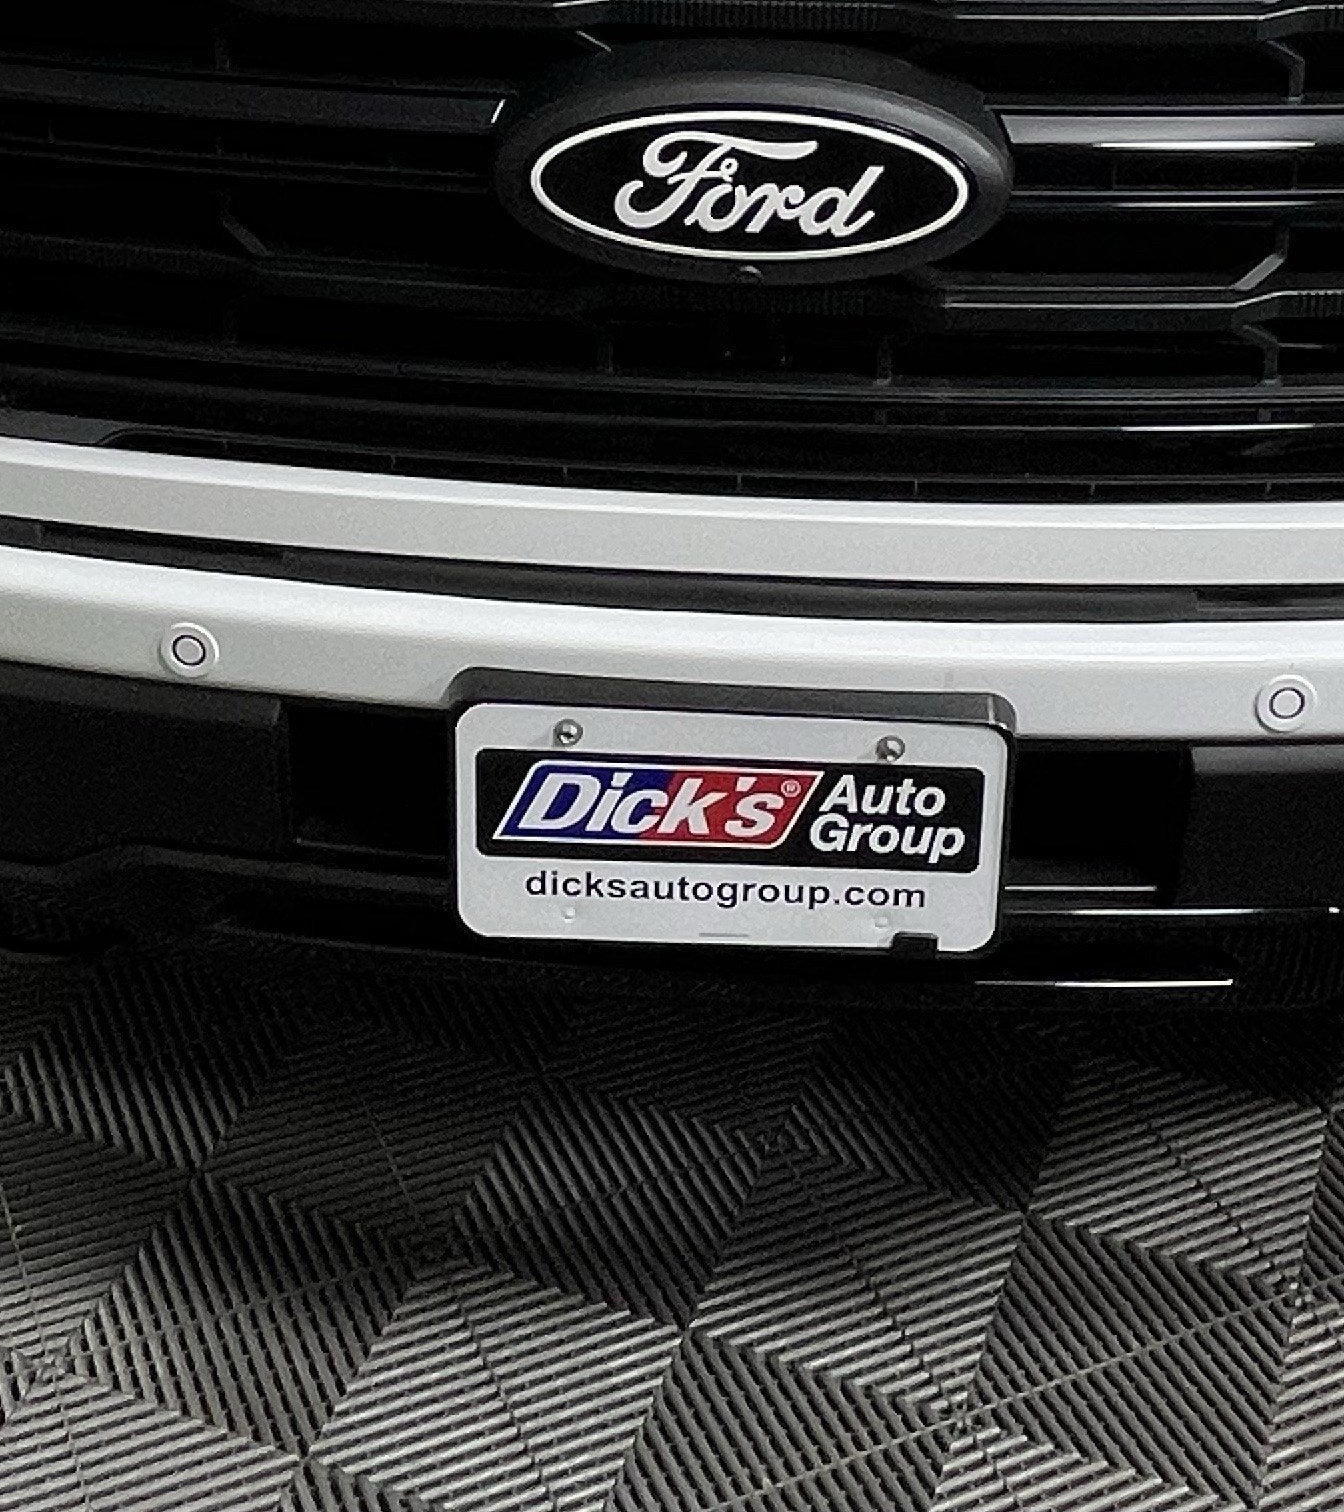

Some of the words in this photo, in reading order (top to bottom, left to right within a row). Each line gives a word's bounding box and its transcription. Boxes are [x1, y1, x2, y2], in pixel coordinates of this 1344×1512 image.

[614, 130, 885, 238] Ford
[818, 775, 946, 816] Auto
[809, 813, 966, 864] Group
[524, 870, 926, 909] dicksautogroup.com
